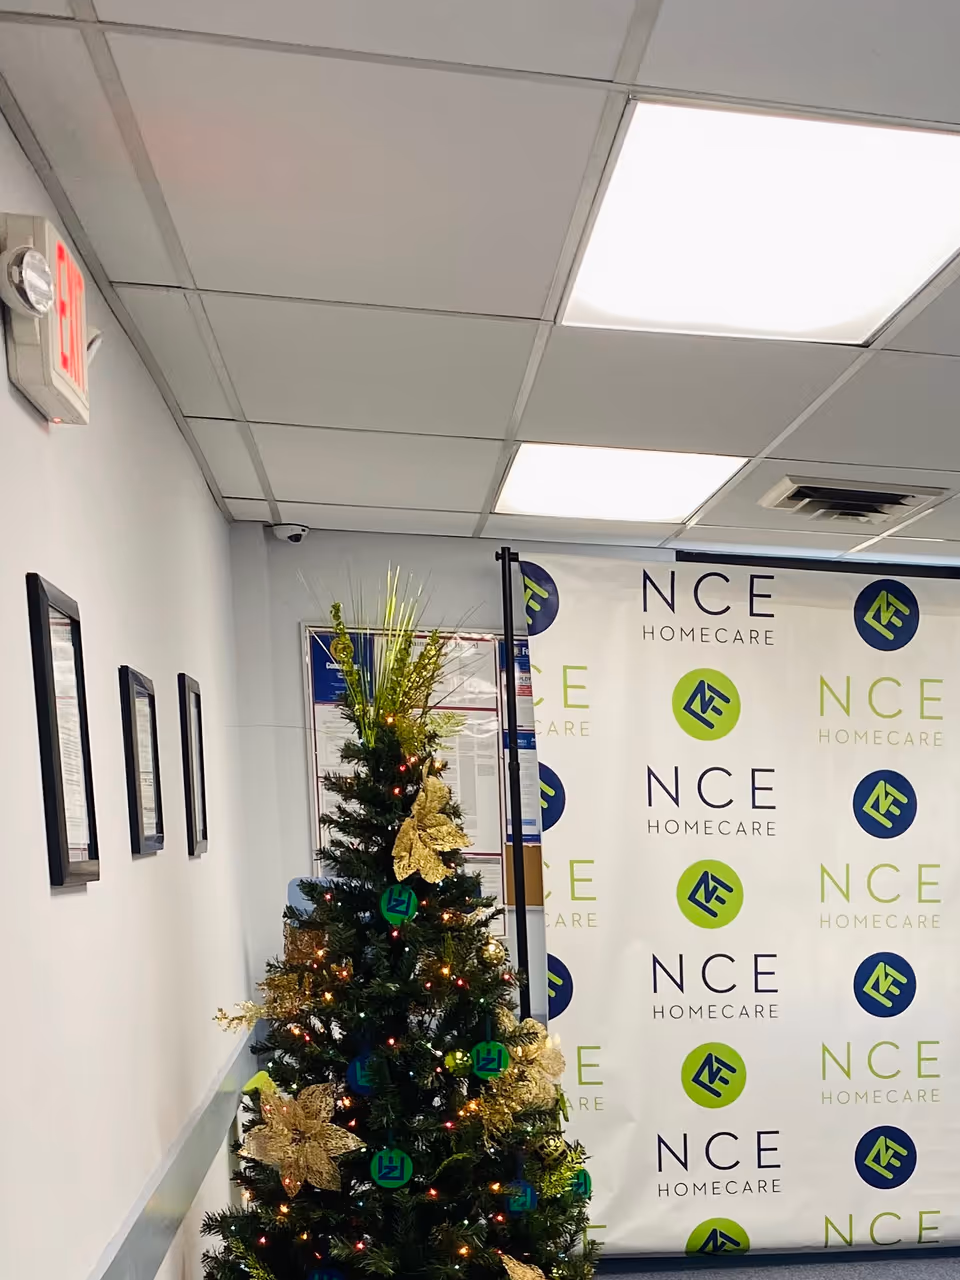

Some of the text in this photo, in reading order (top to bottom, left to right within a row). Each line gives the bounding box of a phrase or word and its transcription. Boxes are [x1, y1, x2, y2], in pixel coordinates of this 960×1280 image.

[56, 240, 86, 392] EXIT
[642, 570, 775, 618] NCE
[643, 626, 773, 645] HOMECARE
[820, 675, 943, 720] NCE
[819, 729, 942, 746] HOMECARE
[647, 766, 776, 809] NCE
[648, 820, 775, 836] HOMECARE
[820, 863, 941, 903] NCE
[820, 914, 940, 928] HOMECARE
[653, 954, 778, 993] NCE
[654, 1004, 777, 1019] HOMECARE
[822, 1041, 940, 1080] NCE
[822, 1089, 939, 1104] HOMECARE
[658, 1131, 780, 1172] NCE
[658, 1179, 780, 1196] HOMECARE
[824, 1211, 940, 1248] NCE
